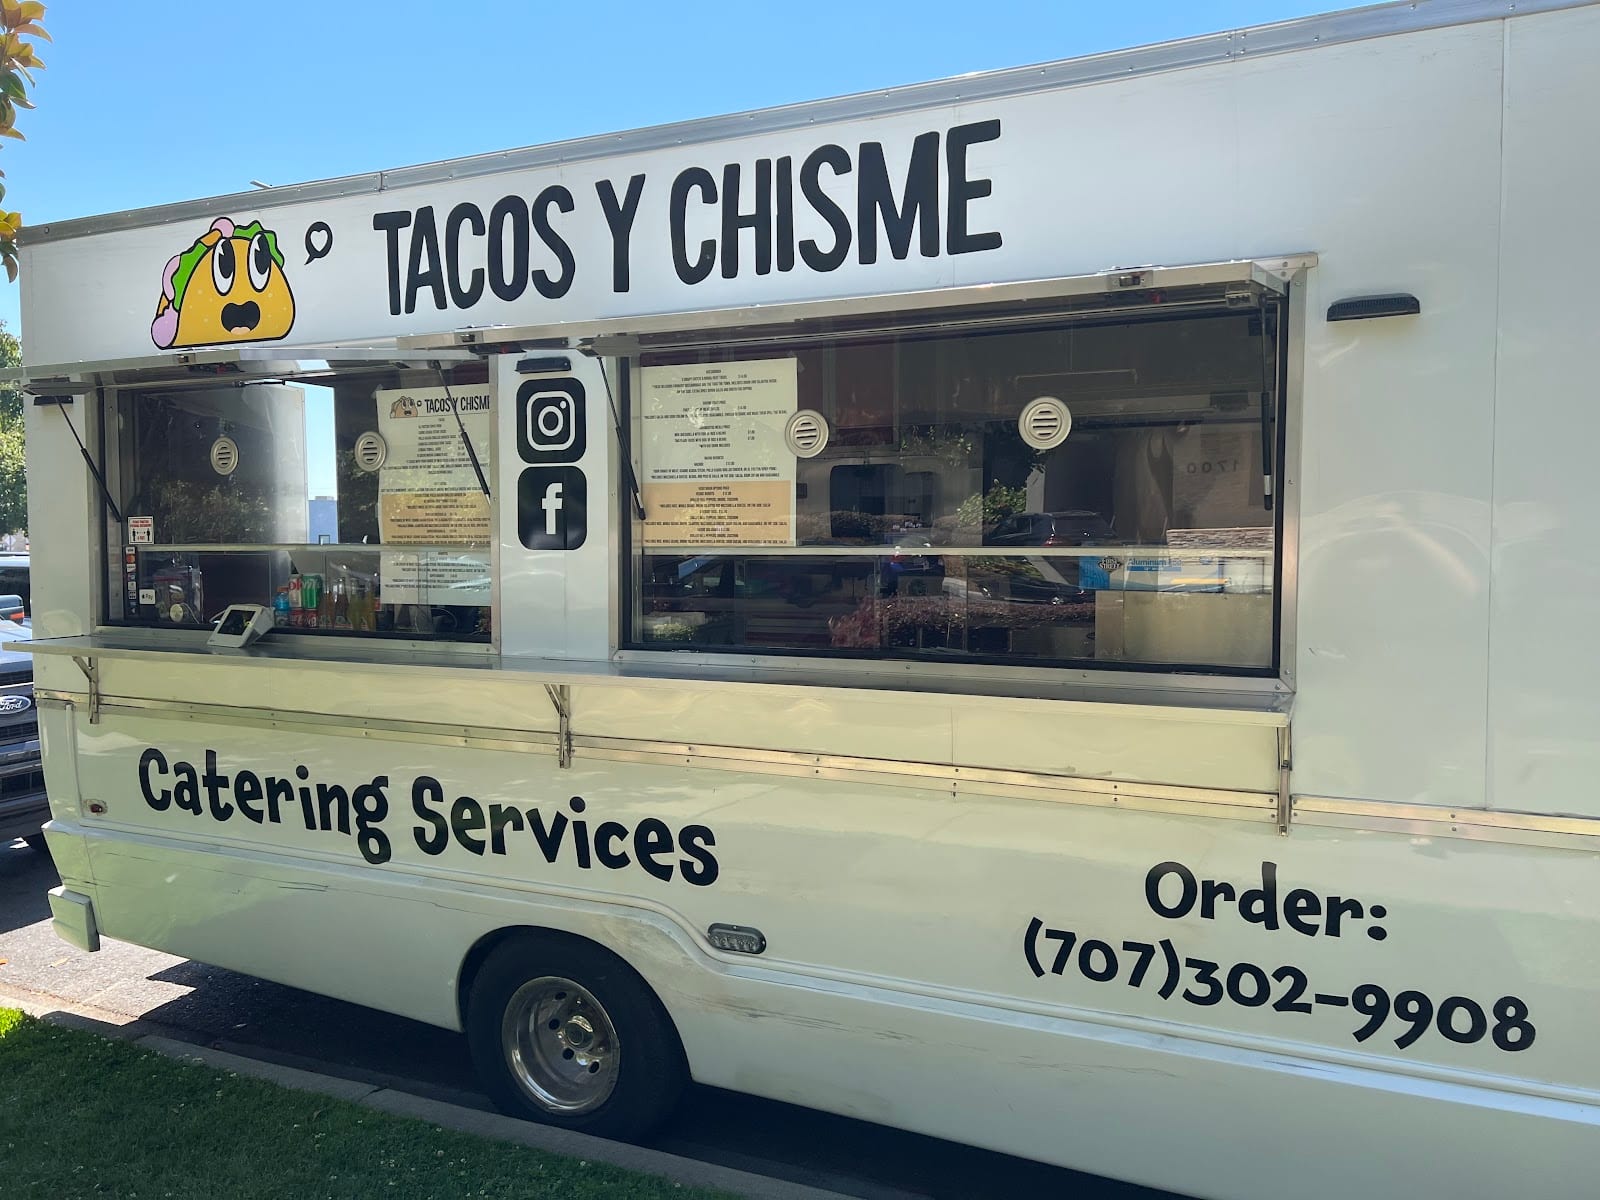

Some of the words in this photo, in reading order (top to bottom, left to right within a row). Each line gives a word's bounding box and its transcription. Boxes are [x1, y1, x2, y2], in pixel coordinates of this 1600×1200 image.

[373, 185, 576, 316] TACOS
[596, 173, 646, 293] Y
[669, 118, 1003, 286] CHISME
[424, 398, 450, 413] TACOS
[0, 697, 22, 710] Ford
[138, 747, 392, 865] Catering
[411, 775, 719, 887] Services
[1145, 861, 1388, 941] Order:
[1023, 916, 1536, 1052] (707)302-9908
